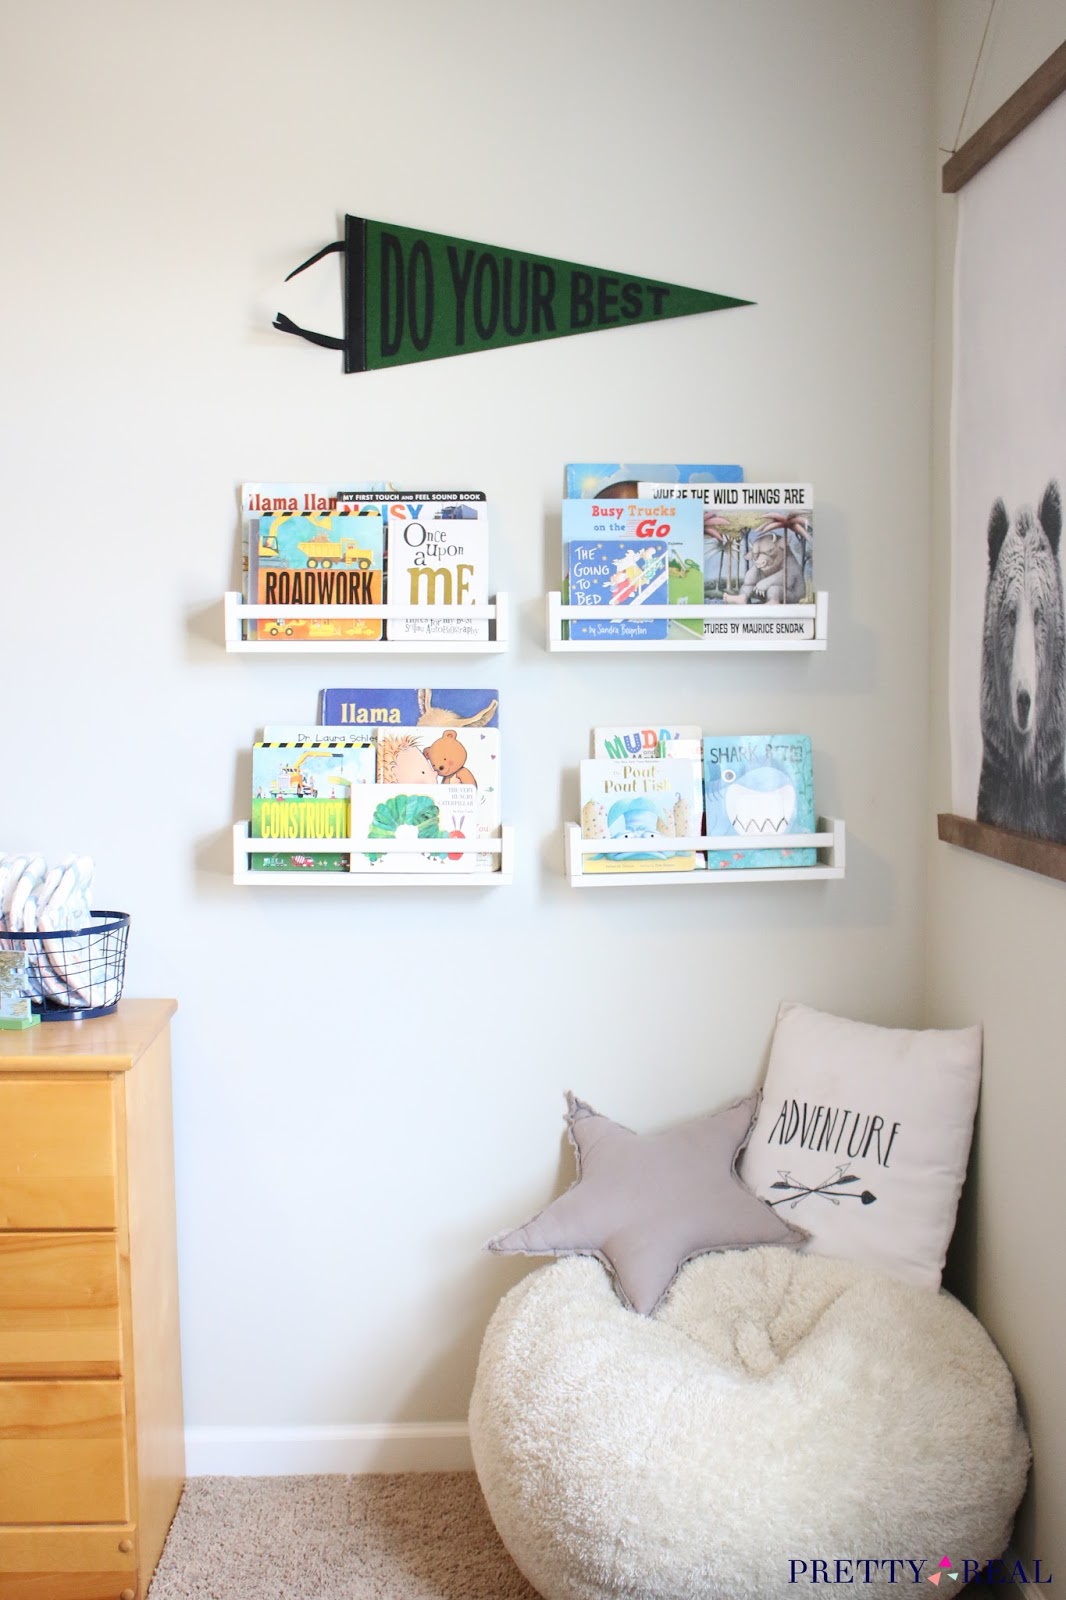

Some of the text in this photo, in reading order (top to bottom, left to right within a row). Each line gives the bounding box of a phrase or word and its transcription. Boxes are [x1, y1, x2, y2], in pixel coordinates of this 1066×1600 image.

[381, 232, 670, 357] DO YOUR BEST
[691, 489, 709, 504] THE
[714, 489, 739, 504] WILD
[742, 489, 780, 504] THINGS
[784, 489, 805, 504] ARE
[591, 505, 676, 520] Busy Trucks
[403, 522, 447, 547] Once
[609, 523, 626, 531] the
[635, 519, 671, 538] Go
[413, 551, 427, 566] a
[574, 546, 598, 560] THE
[573, 562, 610, 578] GOING
[265, 571, 374, 605] ROADWORK
[576, 578, 591, 590] TO
[575, 591, 602, 605] BED
[588, 625, 597, 637] by
[597, 623, 620, 635] Sandra
[730, 623, 740, 634] BY
[742, 623, 774, 634] MAURICE
[776, 623, 804, 634] SENDAK
[341, 703, 401, 723] llama
[298, 733, 312, 742] Dr.
[315, 733, 346, 742] Laura
[710, 742, 758, 764] SHARK
[603, 779, 637, 793] Pout
[768, 1099, 901, 1168] ADVENTURE
